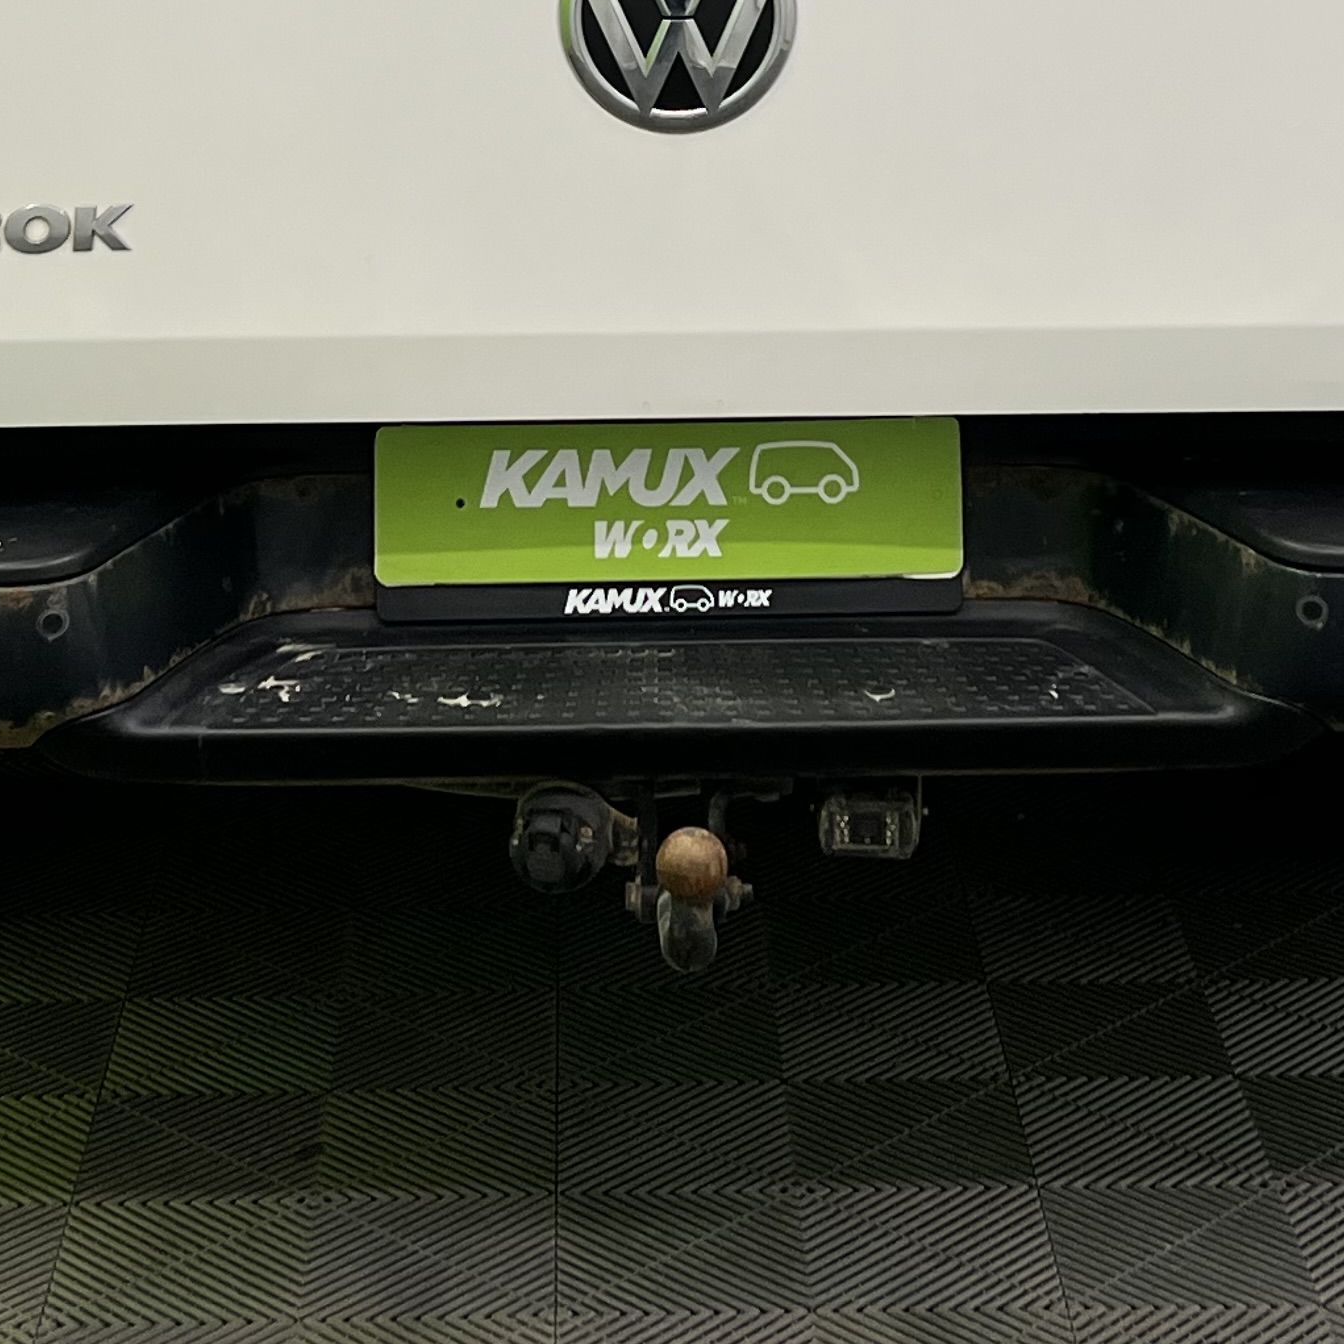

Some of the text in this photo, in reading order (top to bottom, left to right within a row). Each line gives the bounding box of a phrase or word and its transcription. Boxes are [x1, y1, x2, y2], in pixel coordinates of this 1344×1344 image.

[479, 447, 741, 509] KAMUX
[594, 518, 730, 559] WORX
[563, 587, 773, 615] KAMUX WORX
